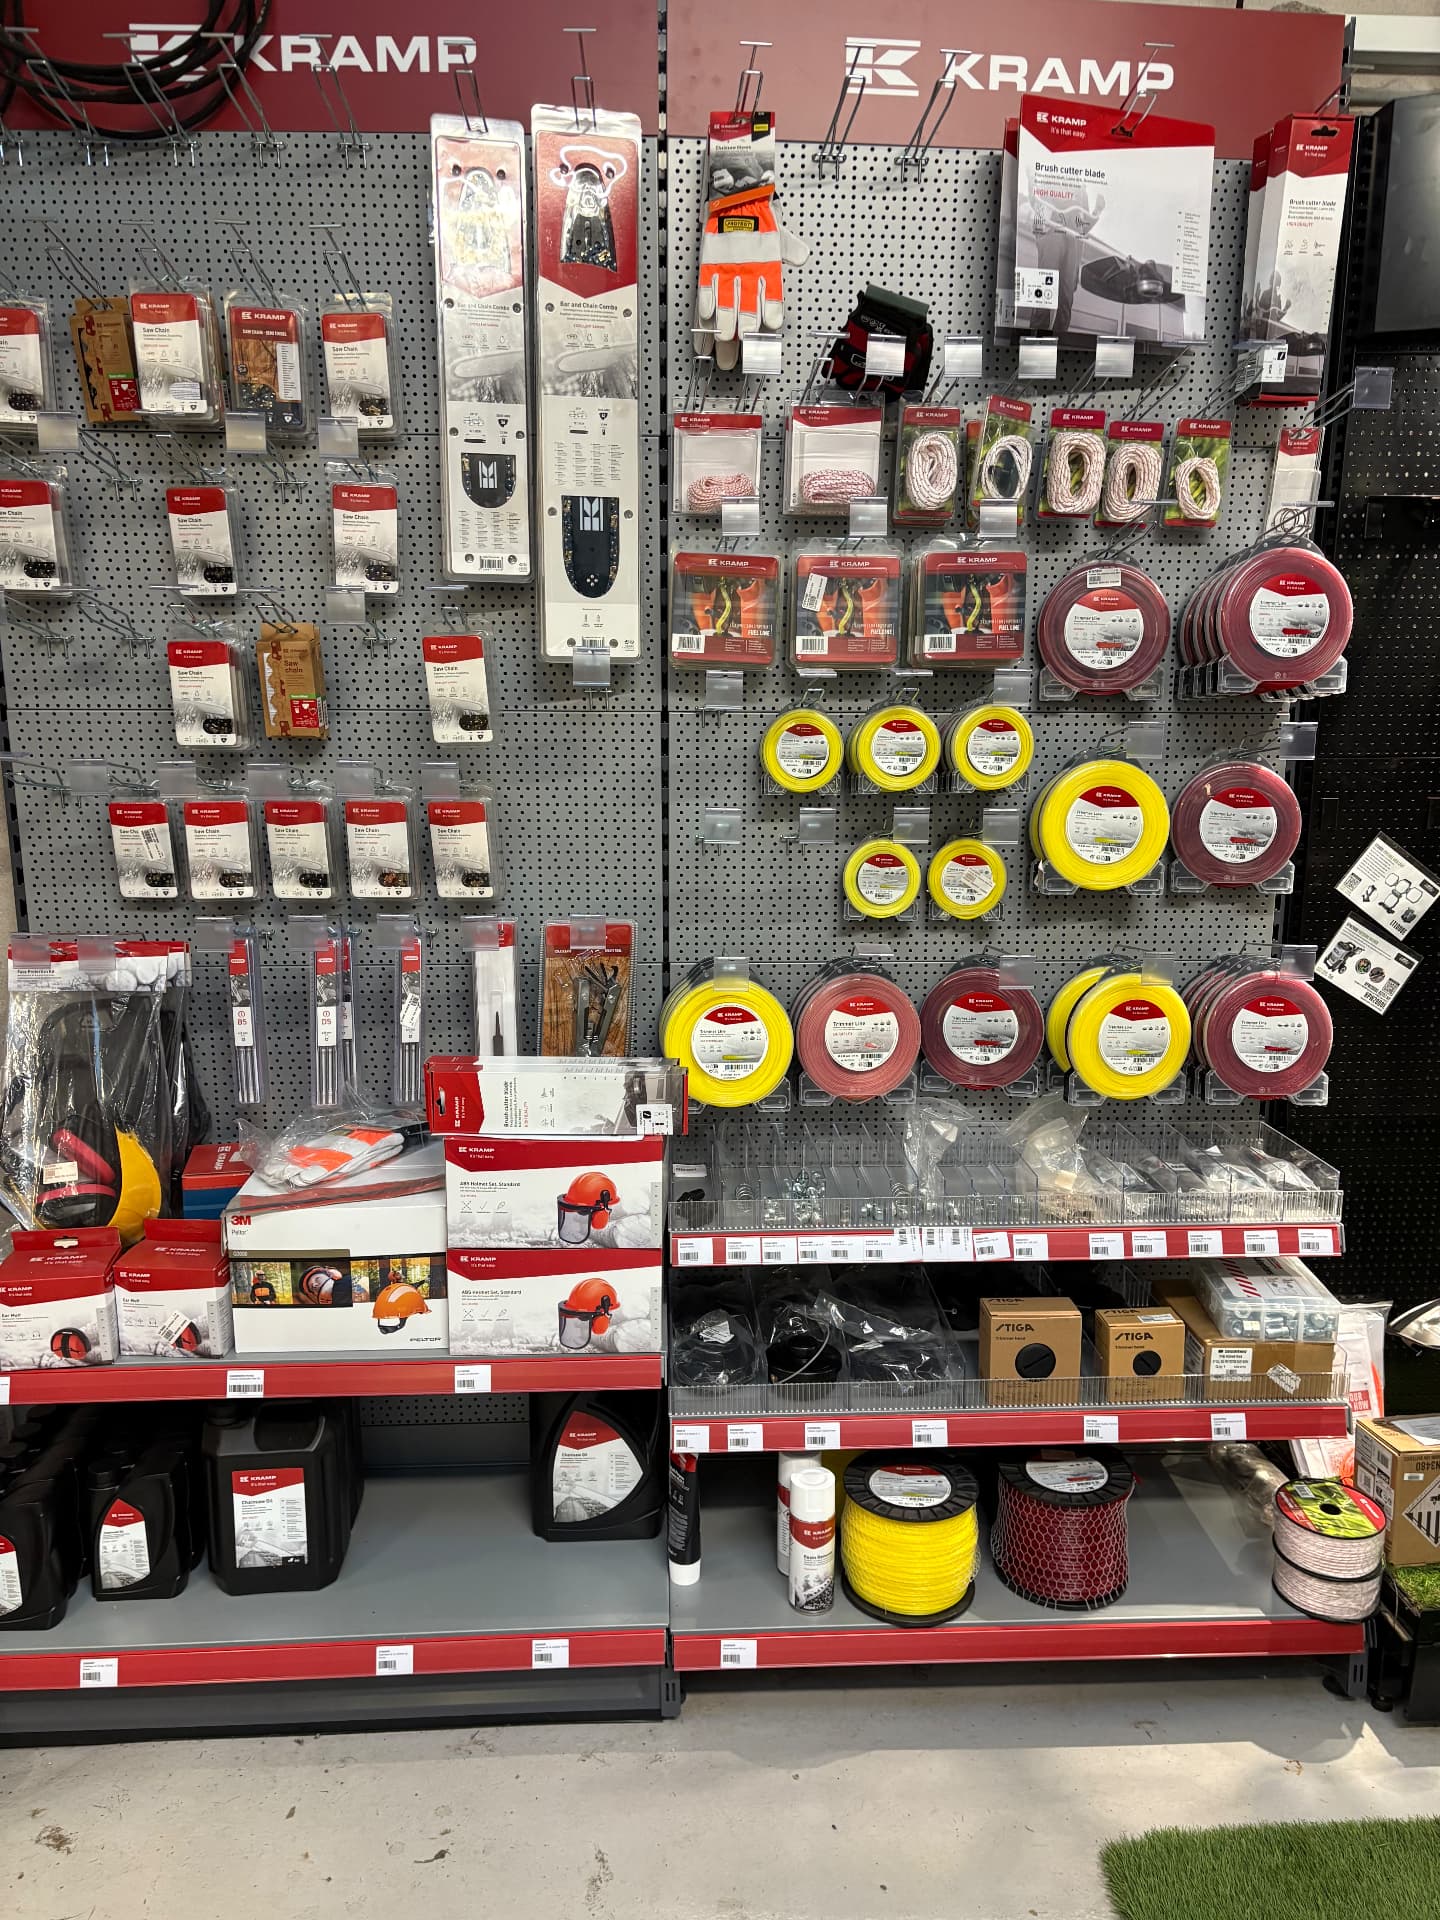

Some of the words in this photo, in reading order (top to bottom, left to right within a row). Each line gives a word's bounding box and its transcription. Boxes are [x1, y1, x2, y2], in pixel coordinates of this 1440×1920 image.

[234, 34, 477, 73] KRAMP
[943, 50, 1175, 97] KRAMP
[1052, 115, 1087, 126] KRAMP
[1035, 162, 1059, 173] Brush
[1060, 166, 1084, 177] cutter
[1085, 168, 1106, 179] blade
[1034, 188, 1048, 197] HIGH
[1049, 190, 1074, 199] QUALITY
[582, 302, 598, 310] Chain
[231, 1215, 251, 1226] 3M
[996, 1323, 1035, 1332] STIGA
[1115, 1332, 1154, 1341] STIGA
